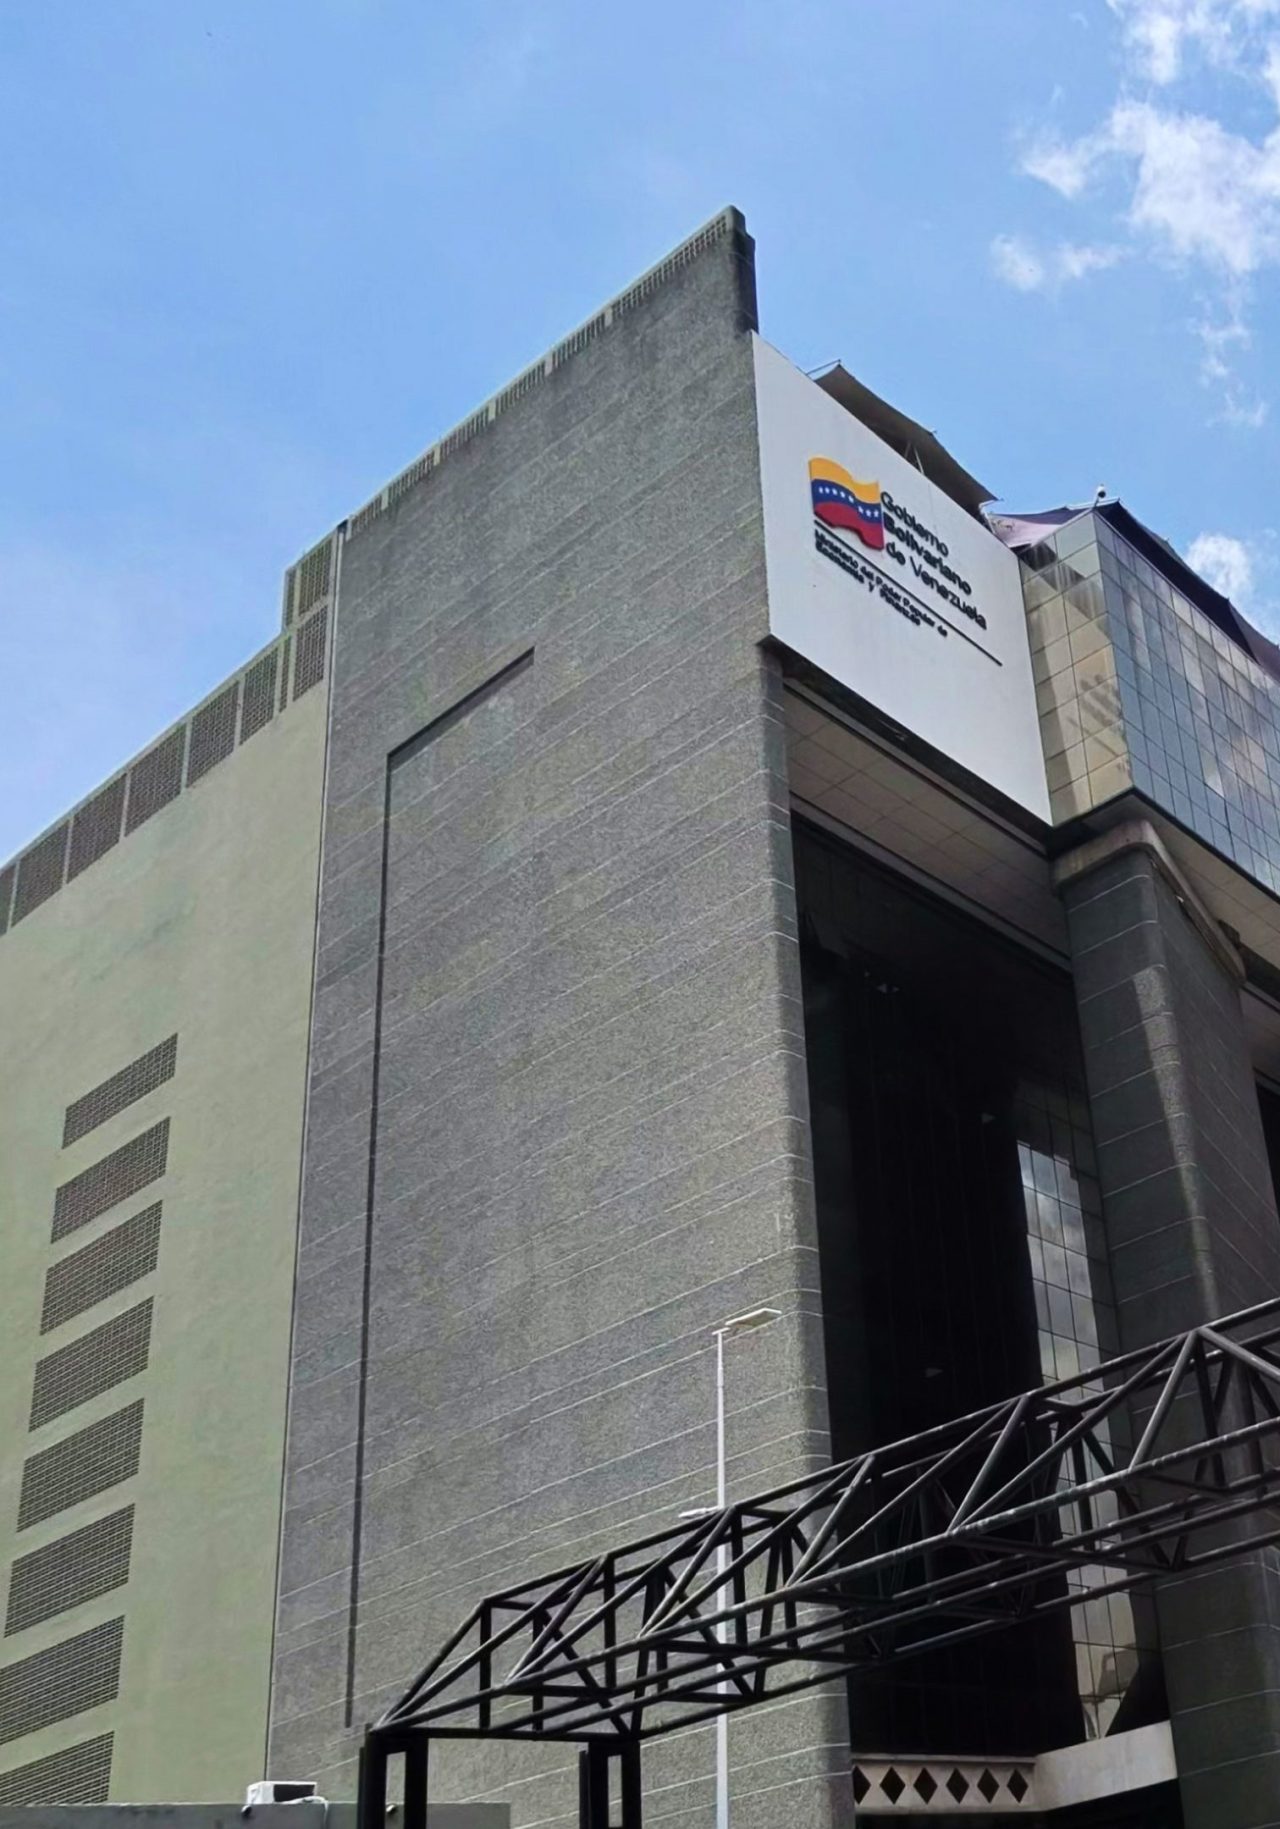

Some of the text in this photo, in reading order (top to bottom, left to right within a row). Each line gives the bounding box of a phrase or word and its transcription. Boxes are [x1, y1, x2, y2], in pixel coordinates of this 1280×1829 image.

[881, 491, 948, 557] Gobierno
[883, 511, 971, 595] Bolivariano
[886, 542, 987, 631] de Venezuela
